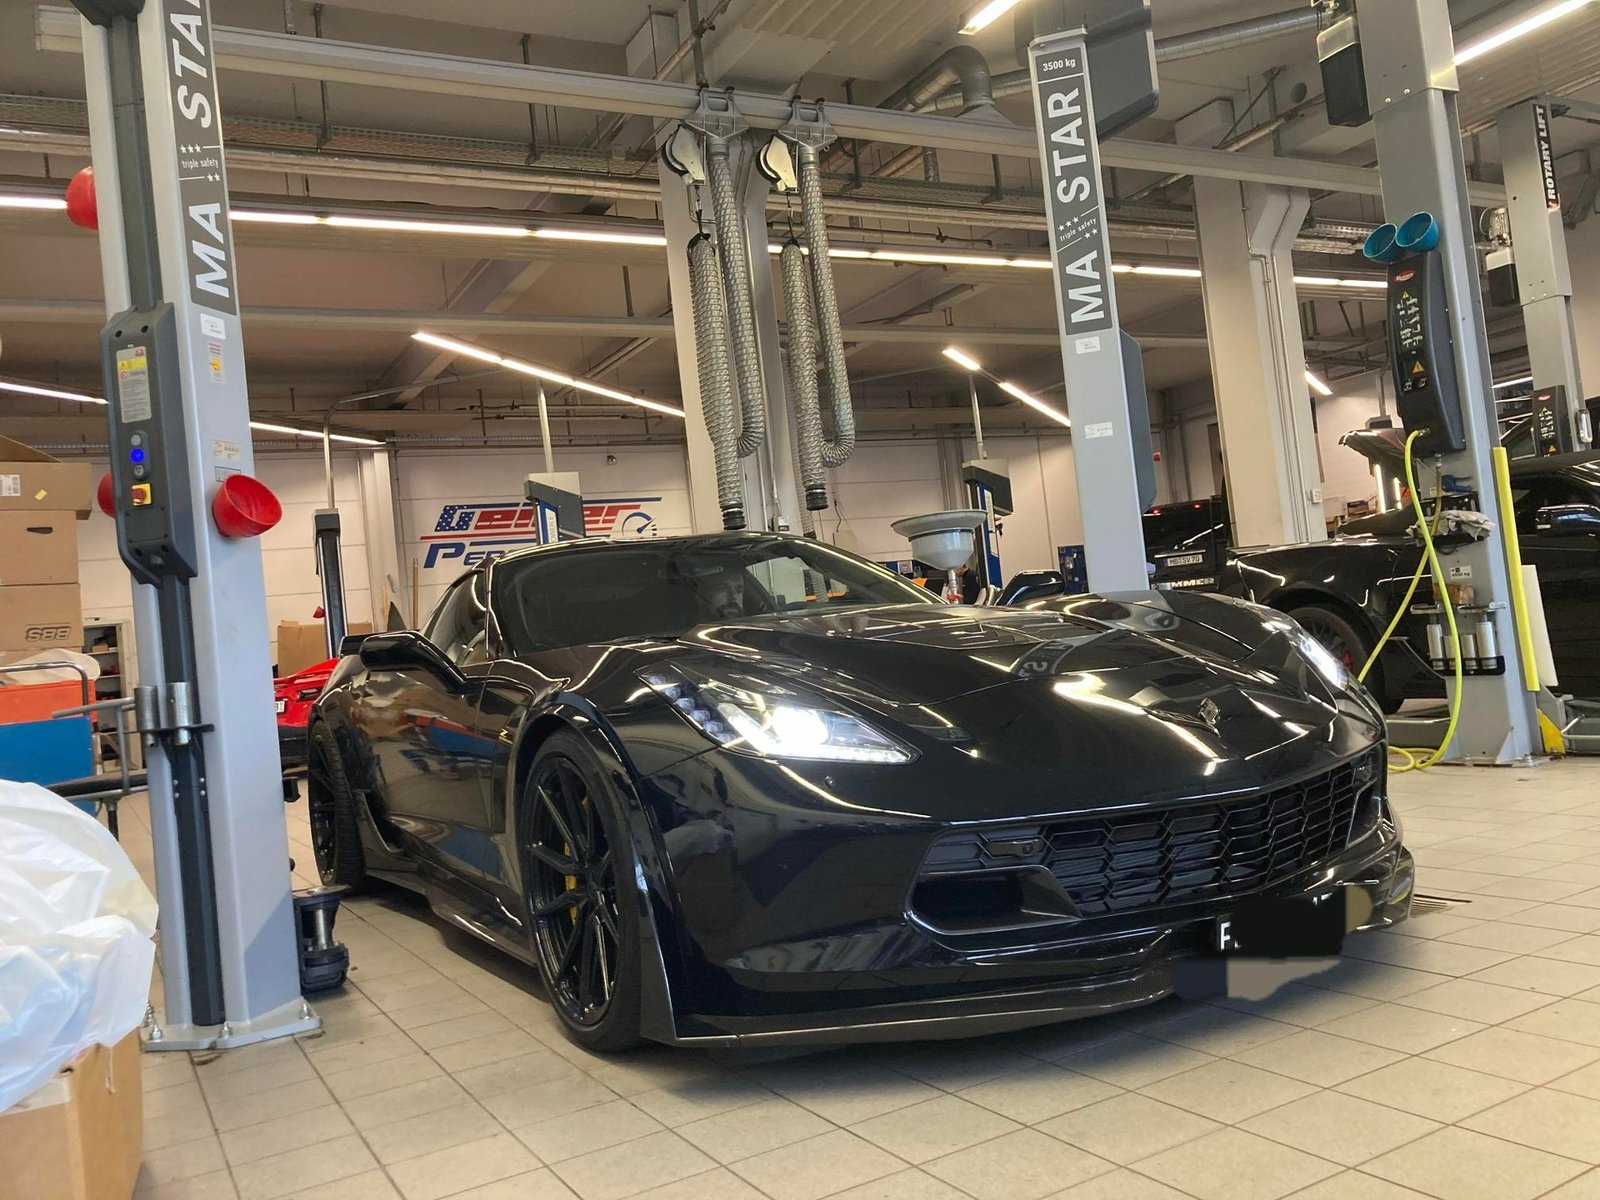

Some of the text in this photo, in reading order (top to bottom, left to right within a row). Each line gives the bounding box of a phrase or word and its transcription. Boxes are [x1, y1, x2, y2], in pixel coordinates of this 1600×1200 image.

[170, 0, 212, 129] STA
[1042, 57, 1076, 72] 3500 kg
[181, 157, 219, 171] triple safety
[1047, 88, 1091, 204] STAR
[1536, 105, 1556, 200] ROTARY LIFT
[189, 202, 230, 299] MA
[1059, 217, 1097, 242] triple safety
[1065, 249, 1105, 324] MA
